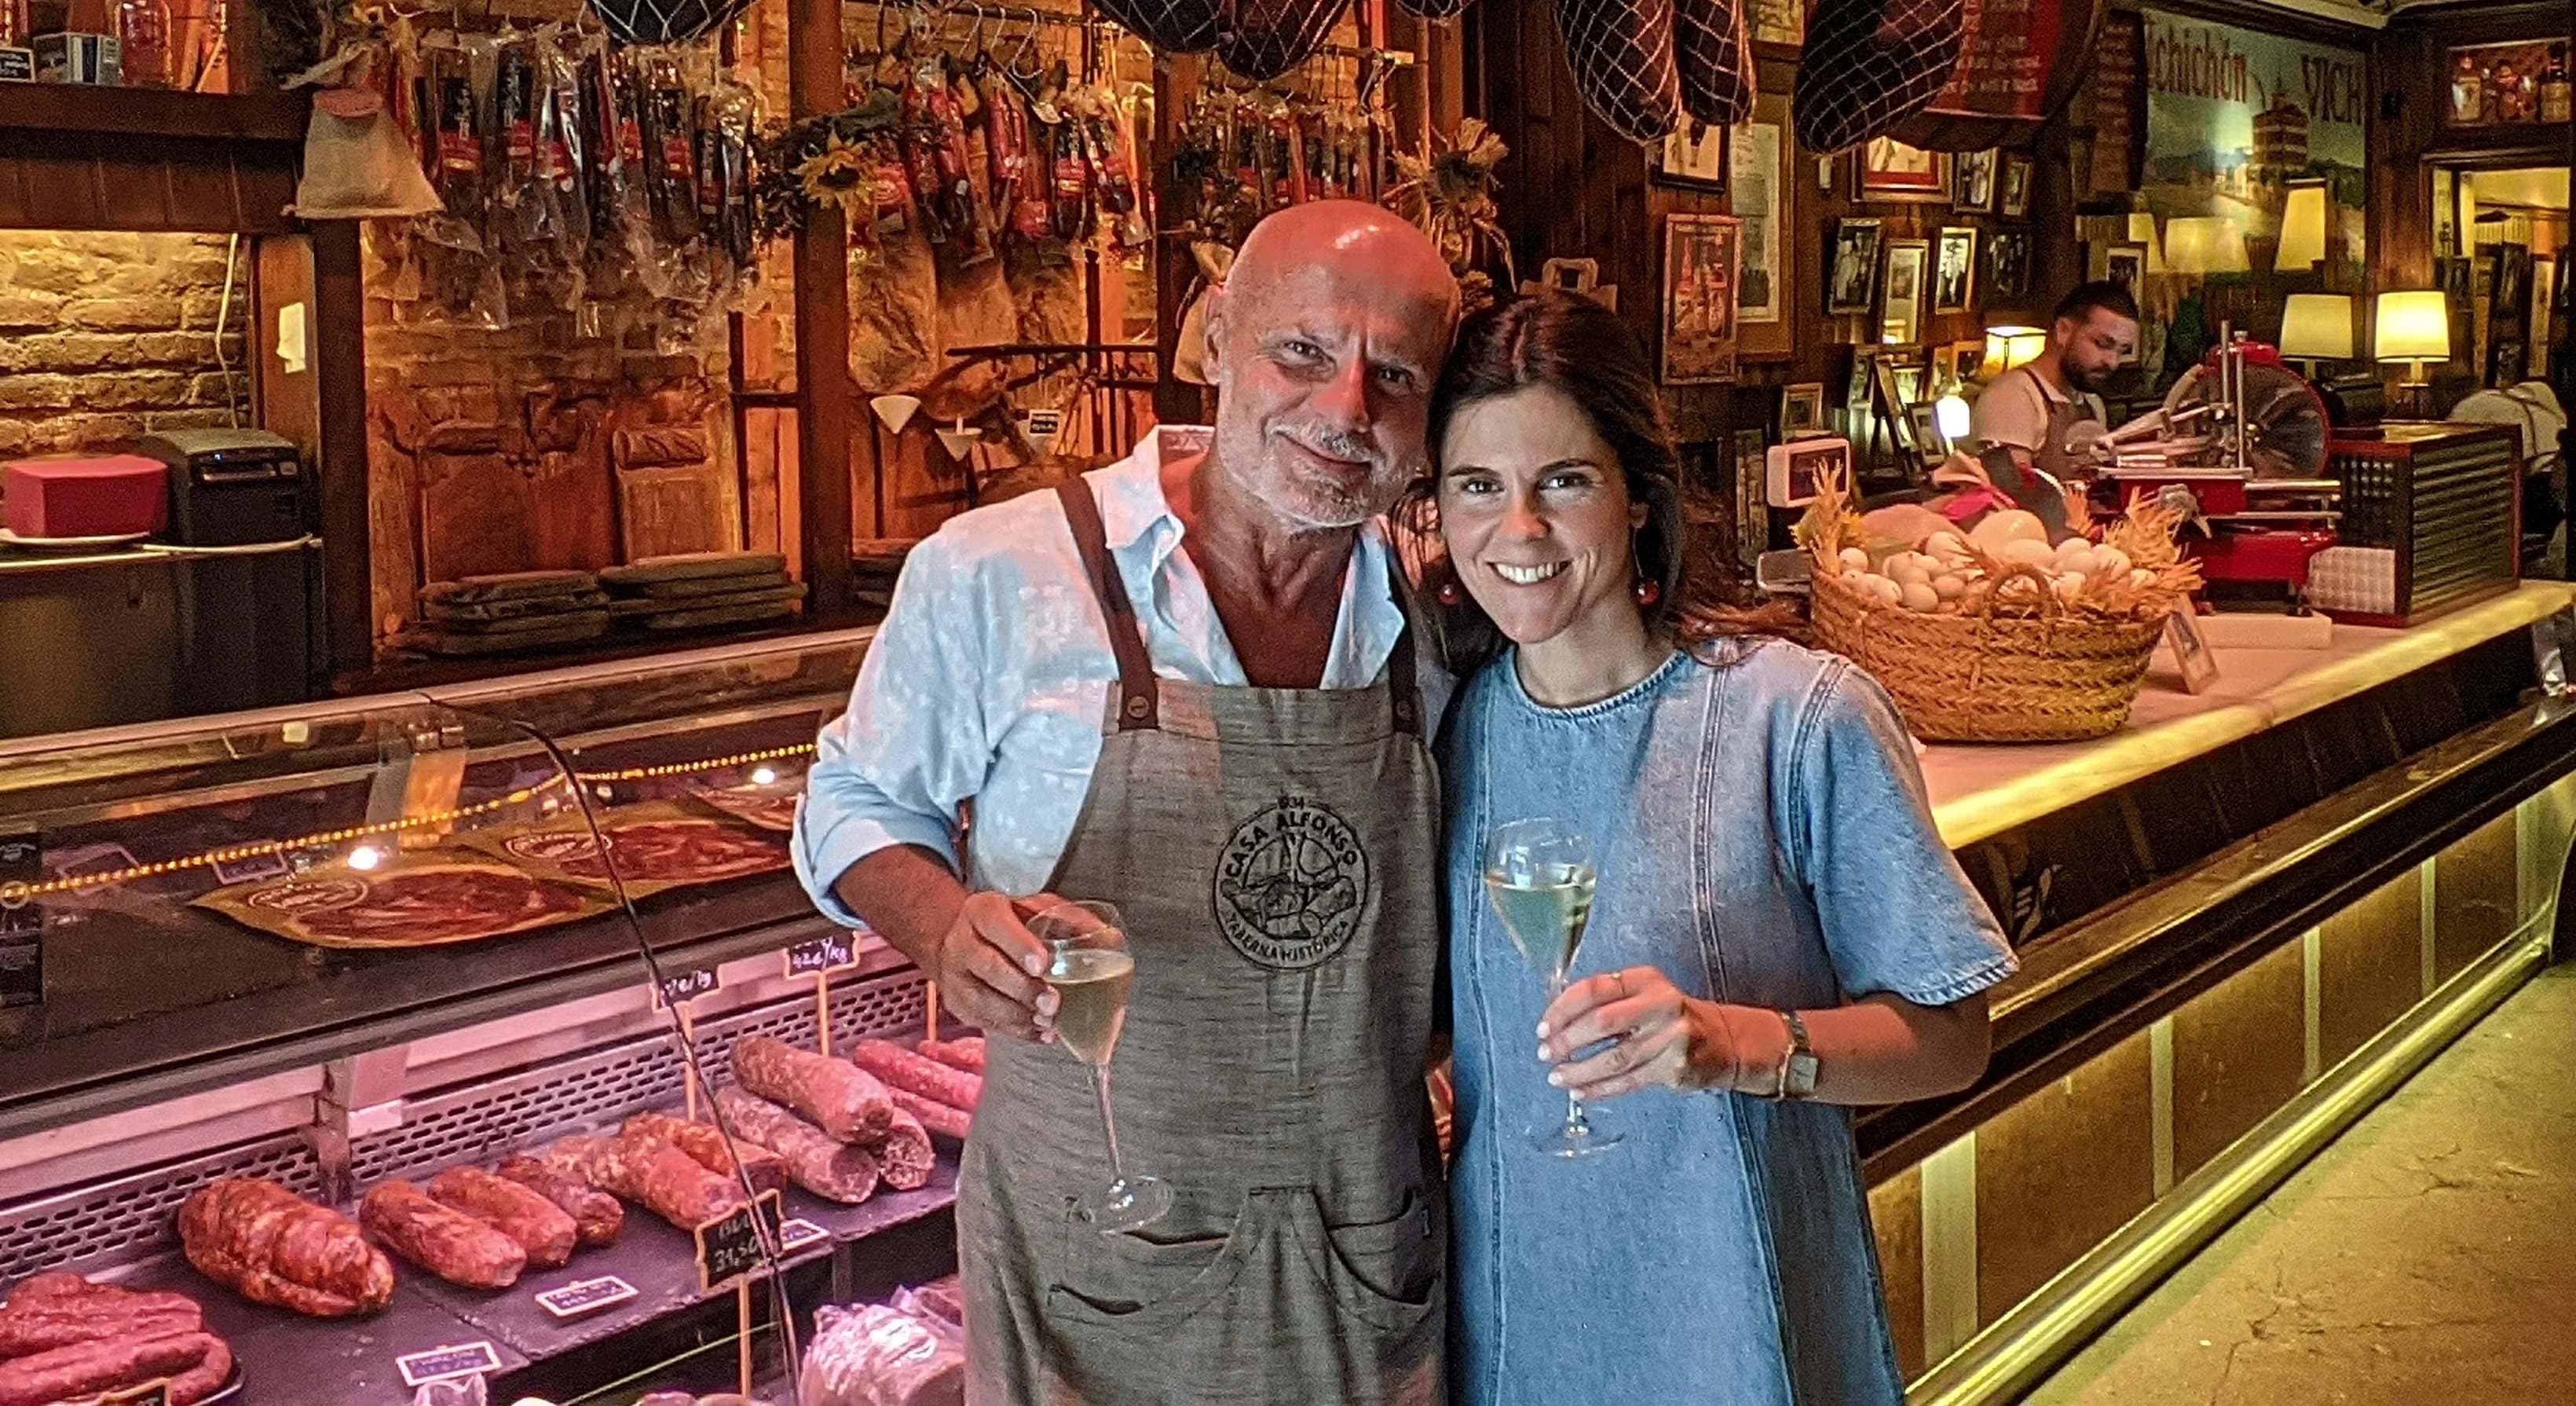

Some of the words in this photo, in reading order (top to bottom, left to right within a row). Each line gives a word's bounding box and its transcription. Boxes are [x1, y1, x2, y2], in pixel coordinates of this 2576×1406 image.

[2301, 54, 2363, 126] VICH
[1224, 826, 1269, 878] CASA
[1275, 811, 1359, 866] ALFONSO
[1224, 913, 1278, 960] TABERNA
